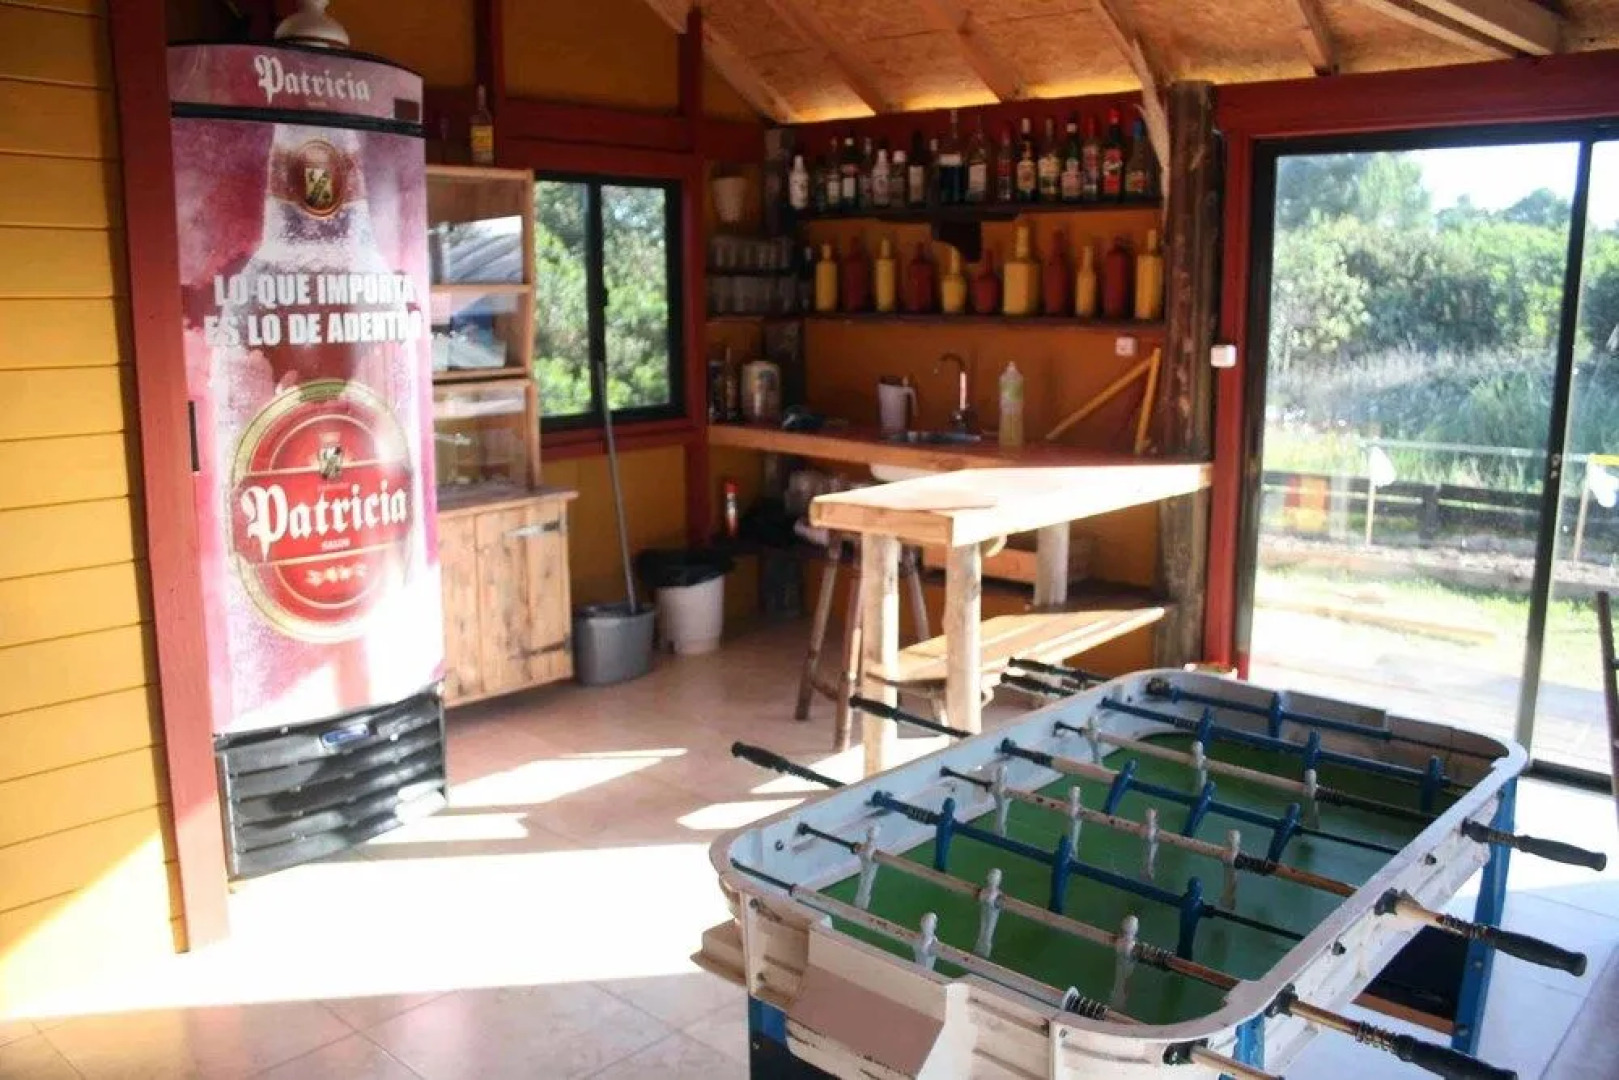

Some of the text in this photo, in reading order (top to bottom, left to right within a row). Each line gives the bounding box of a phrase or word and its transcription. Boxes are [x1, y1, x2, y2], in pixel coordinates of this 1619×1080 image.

[255, 55, 370, 103] Patricia
[213, 273, 418, 309] LO QUE IMPORTA
[204, 315, 240, 345] ES
[248, 313, 281, 345] LO
[288, 313, 322, 345] DE
[240, 479, 408, 562] Patricia
